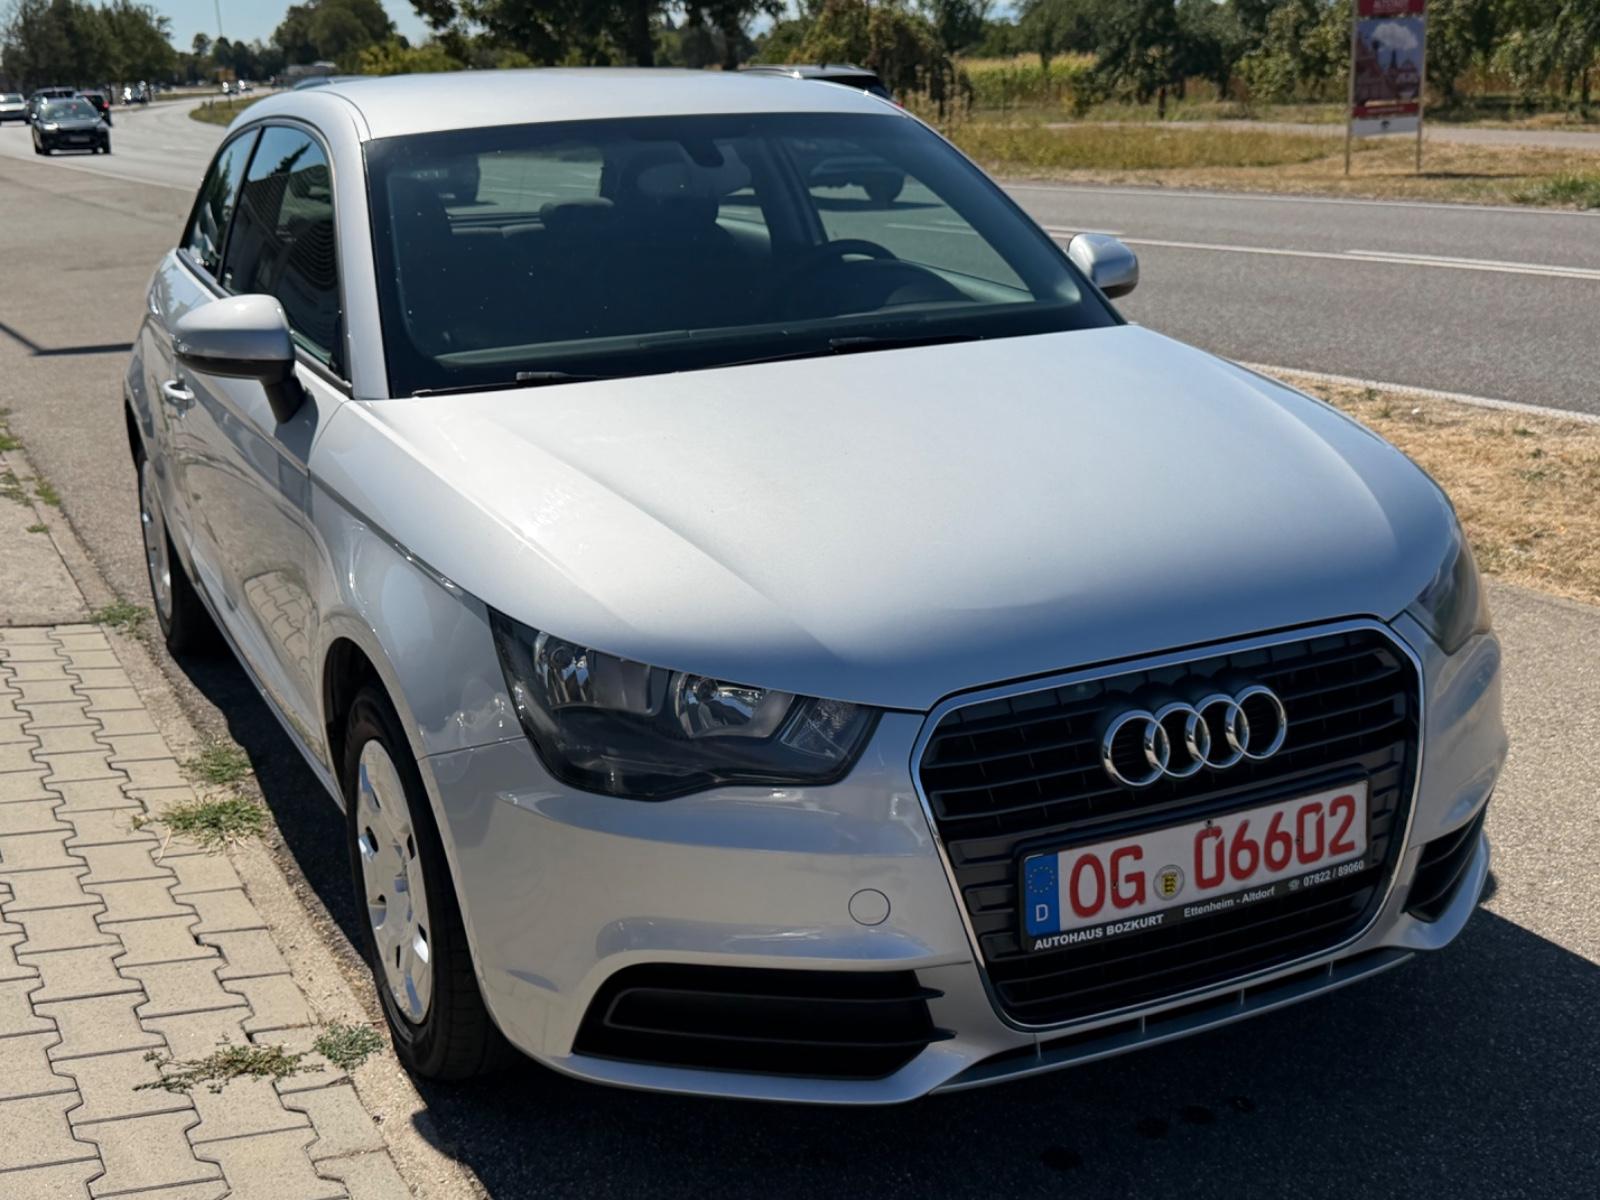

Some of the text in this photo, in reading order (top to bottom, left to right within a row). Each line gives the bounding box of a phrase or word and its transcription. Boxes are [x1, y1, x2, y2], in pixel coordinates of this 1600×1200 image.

[1069, 794, 1356, 918] OG 06602
[1034, 928, 1103, 951] AUTOHAUS
[1106, 914, 1164, 936] BOZKURT
[1184, 898, 1234, 918] Ettenheim
[1242, 886, 1276, 904] Altdorf
[1303, 869, 1331, 888] 07822
[1338, 860, 1365, 877] 89060
[1036, 904, 1049, 922] D
